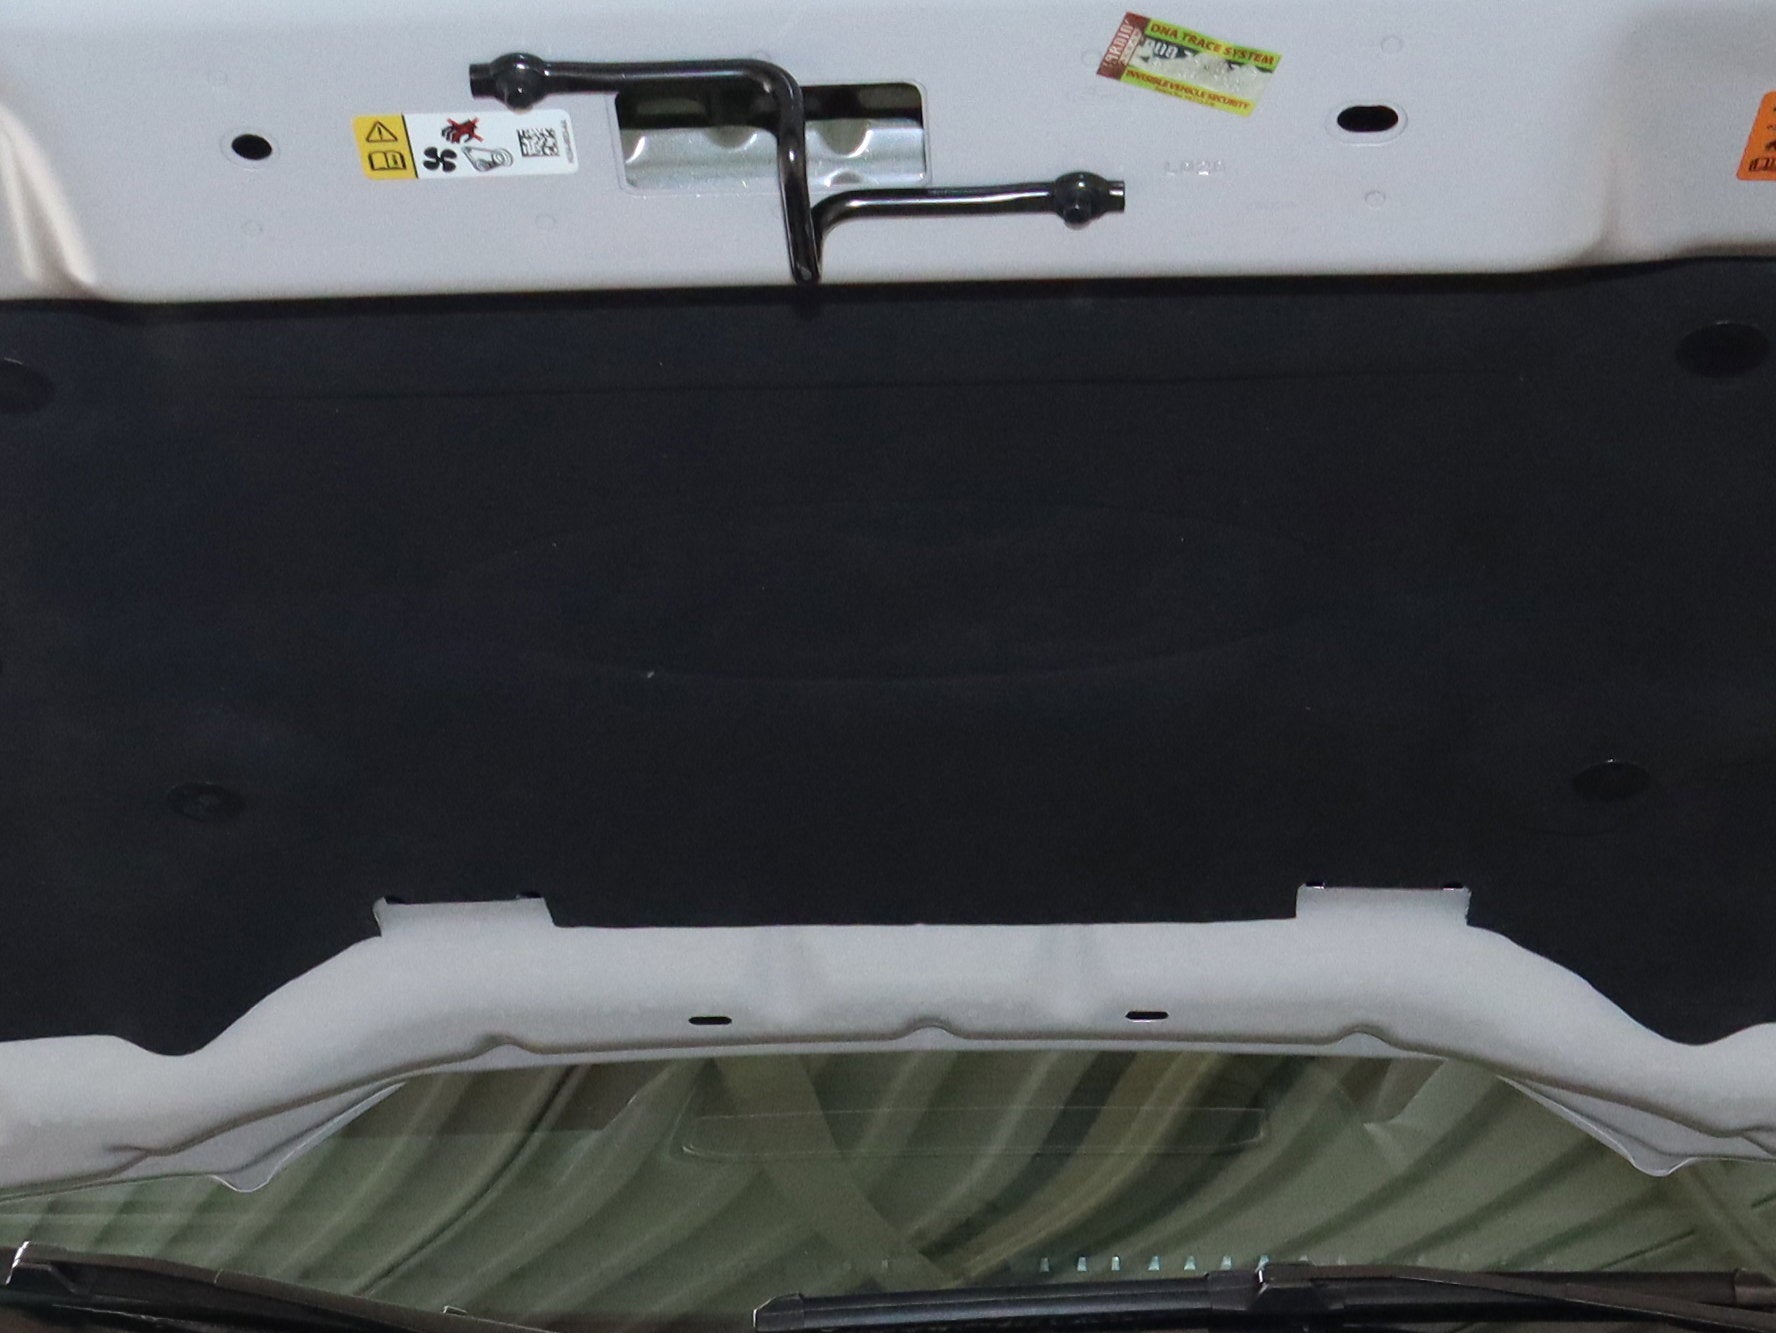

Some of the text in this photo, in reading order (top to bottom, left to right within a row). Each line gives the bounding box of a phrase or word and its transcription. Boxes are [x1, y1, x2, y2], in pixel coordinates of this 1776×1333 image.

[1150, 22, 1178, 40] DNA
[1181, 30, 1222, 55] TRACE
[1222, 45, 1276, 66] SYSTEM
[1169, 81, 1210, 100] VEHICLE
